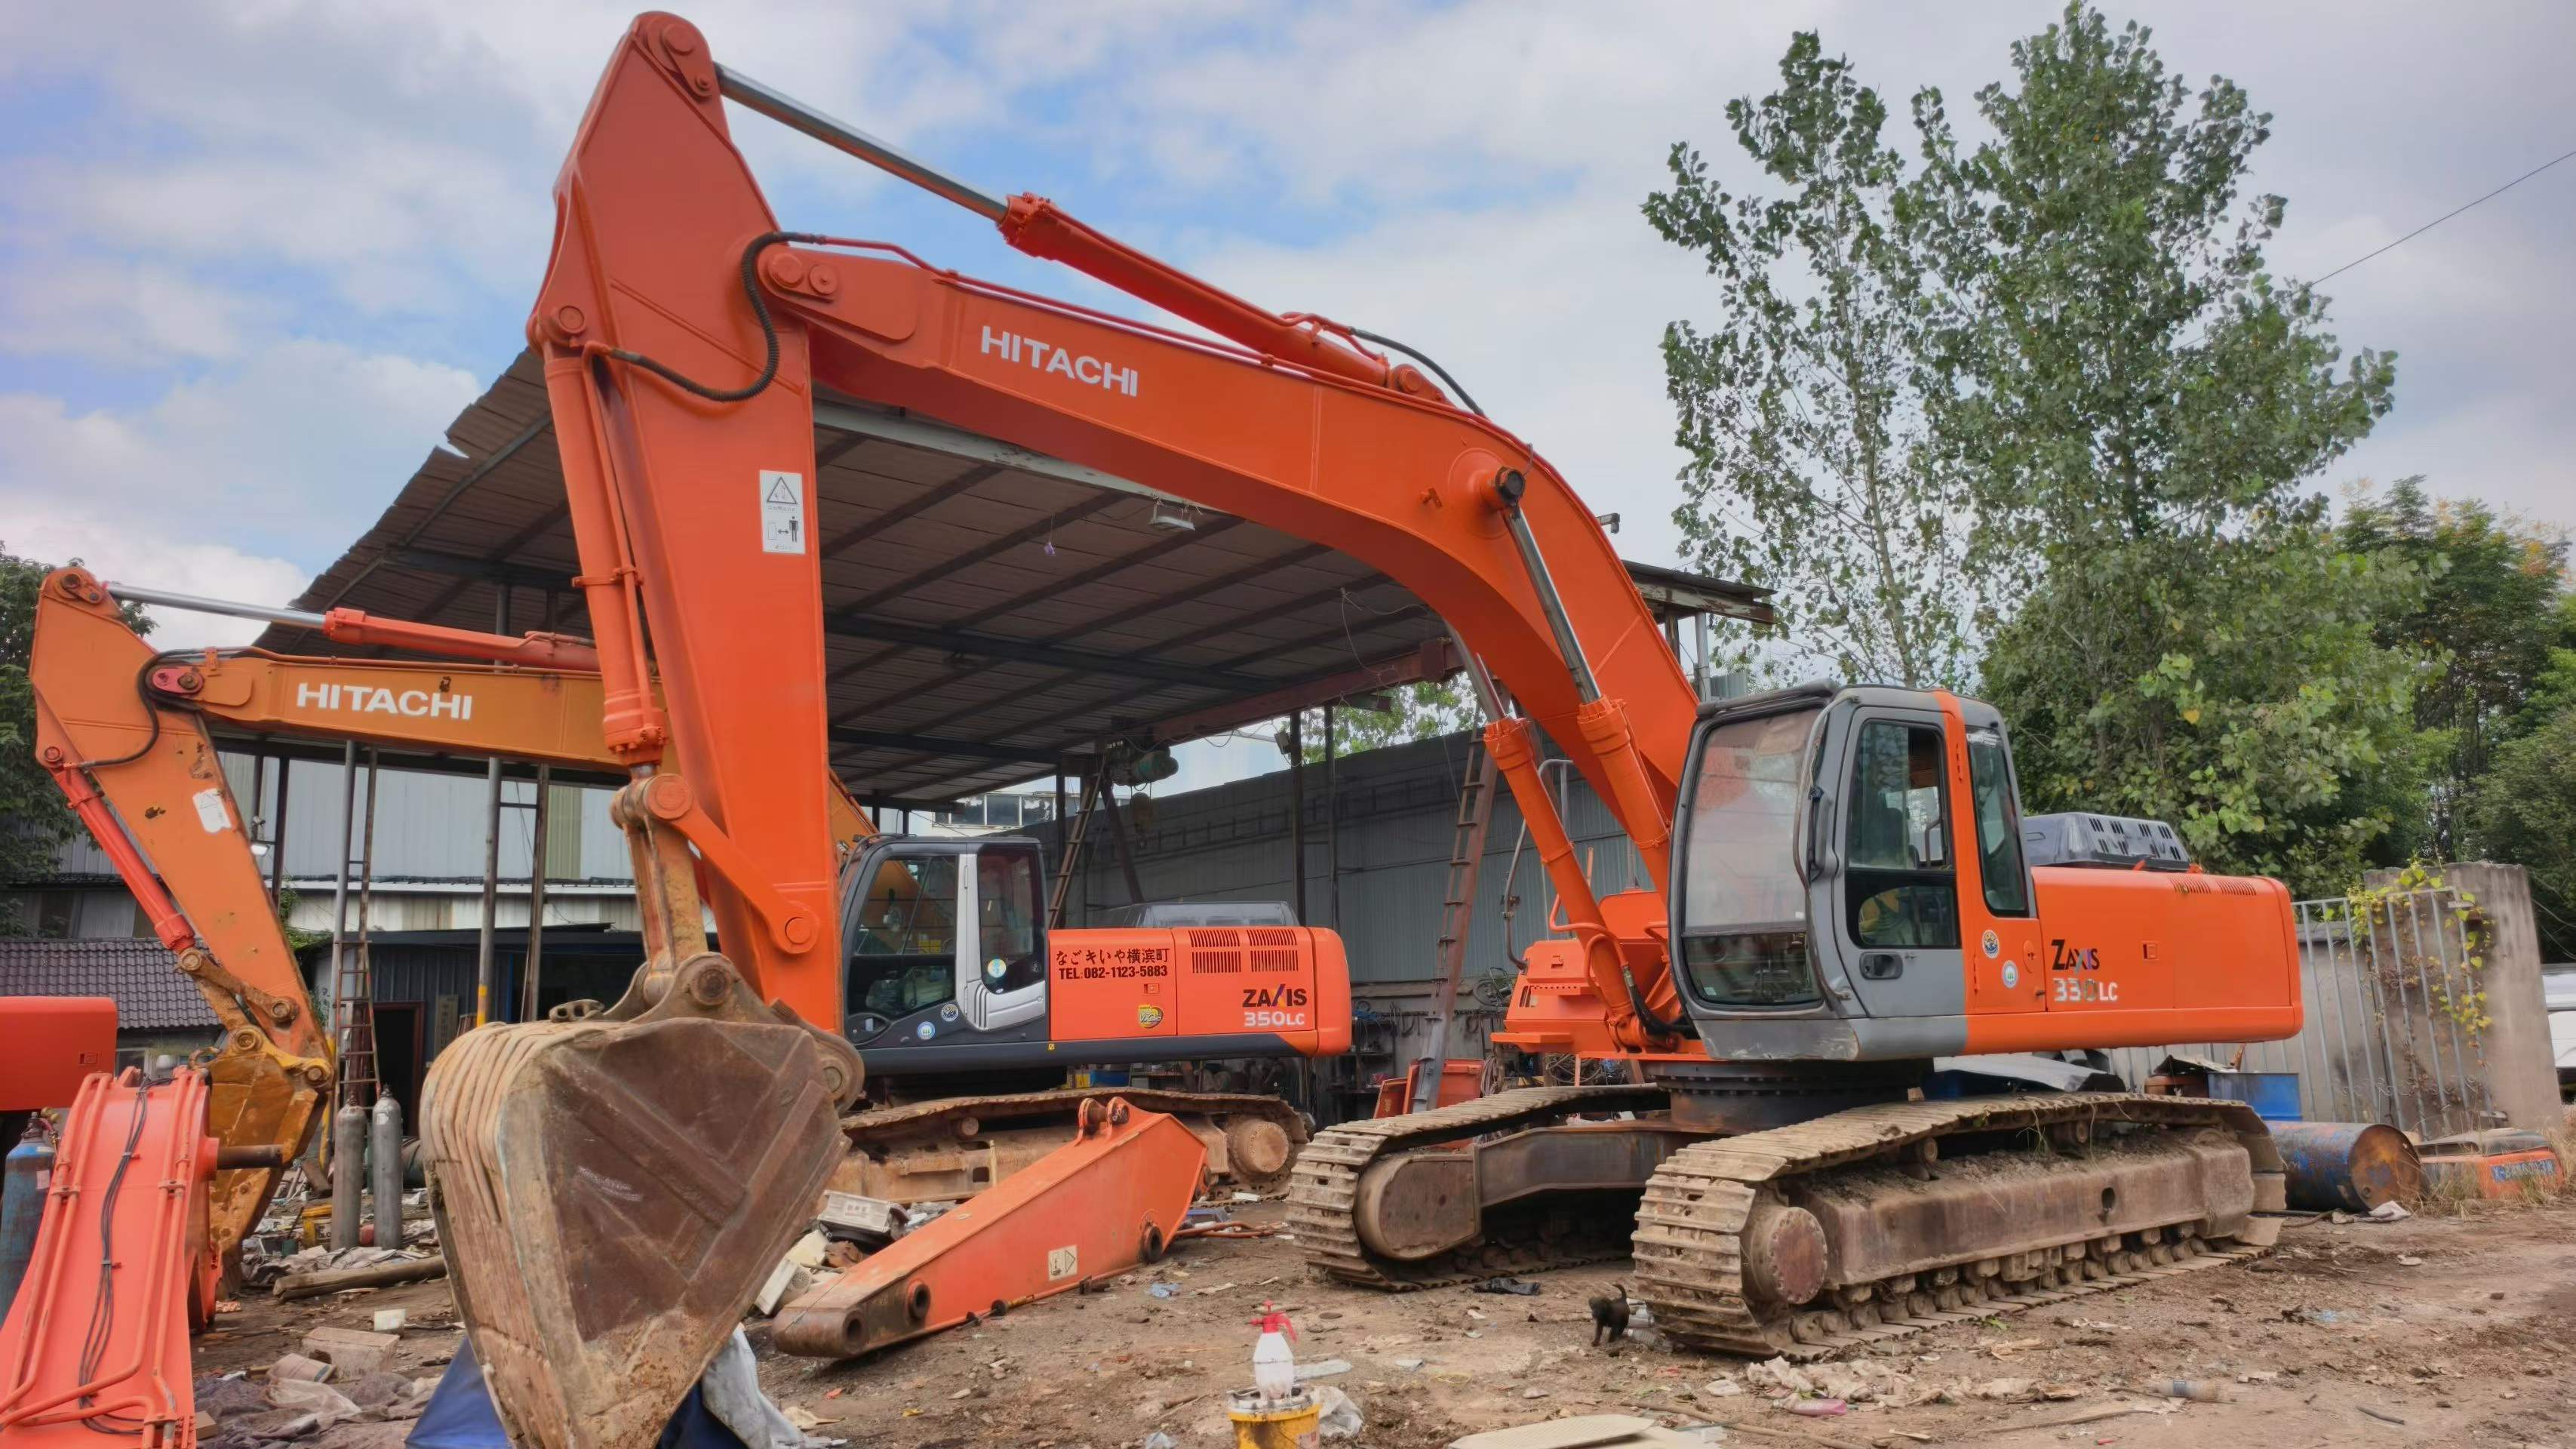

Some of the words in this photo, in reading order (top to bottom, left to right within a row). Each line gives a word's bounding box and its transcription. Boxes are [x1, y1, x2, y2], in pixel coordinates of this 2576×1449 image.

[981, 325, 1138, 397] HITACHI
[297, 682, 472, 720] HITACHI
[2051, 939, 2101, 972] ZAXIS
[1242, 983, 1308, 1008] ZAXIS
[2053, 978, 2119, 1001] 330LC
[1244, 1011, 1305, 1027] 350LC
